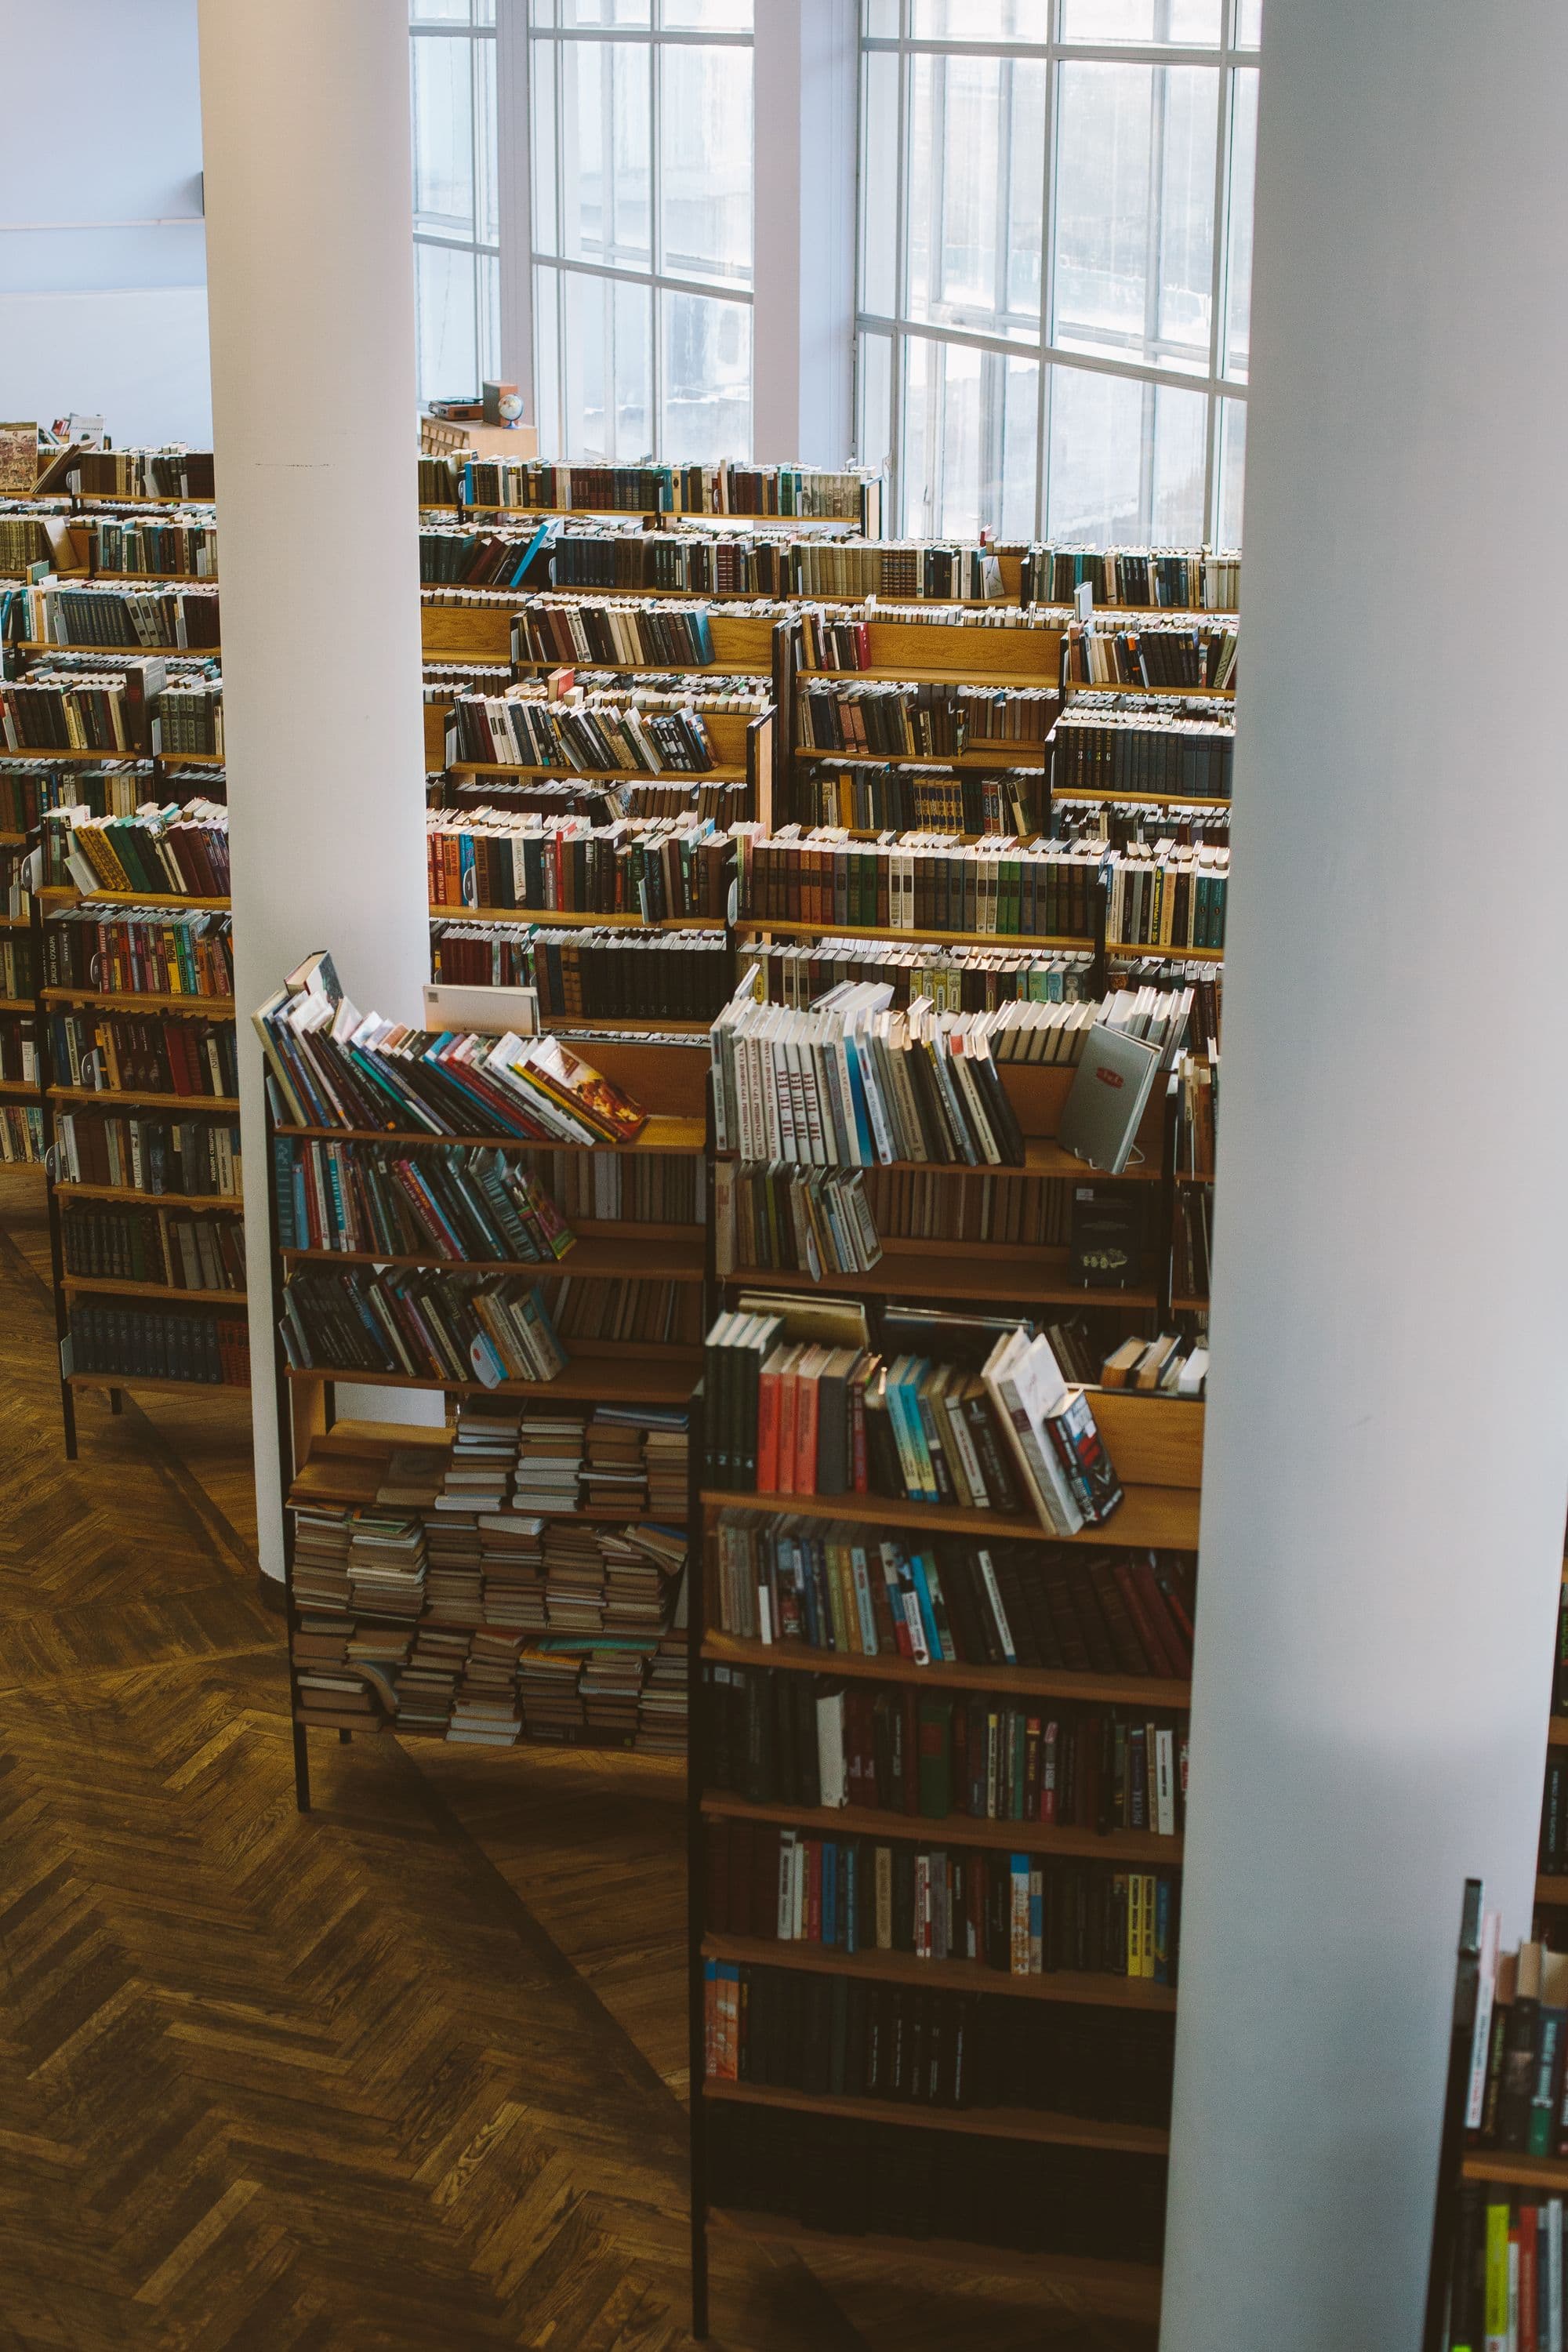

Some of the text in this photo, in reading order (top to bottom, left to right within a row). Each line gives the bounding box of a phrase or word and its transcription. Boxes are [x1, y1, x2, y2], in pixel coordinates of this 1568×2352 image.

[739, 1065, 747, 1100] ТРУДОВОЙ
[778, 1071, 793, 1138] ЗИЛ XXI ВЕК
[790, 1073, 807, 1139] ЗИЛ XXI ВЕК
[803, 1073, 820, 1141] ЗИЛ XXI ВЕК
[741, 1103, 750, 1141] СТРАНИЦЫ
[768, 1106, 776, 1143] СТРАНИЦЫ
